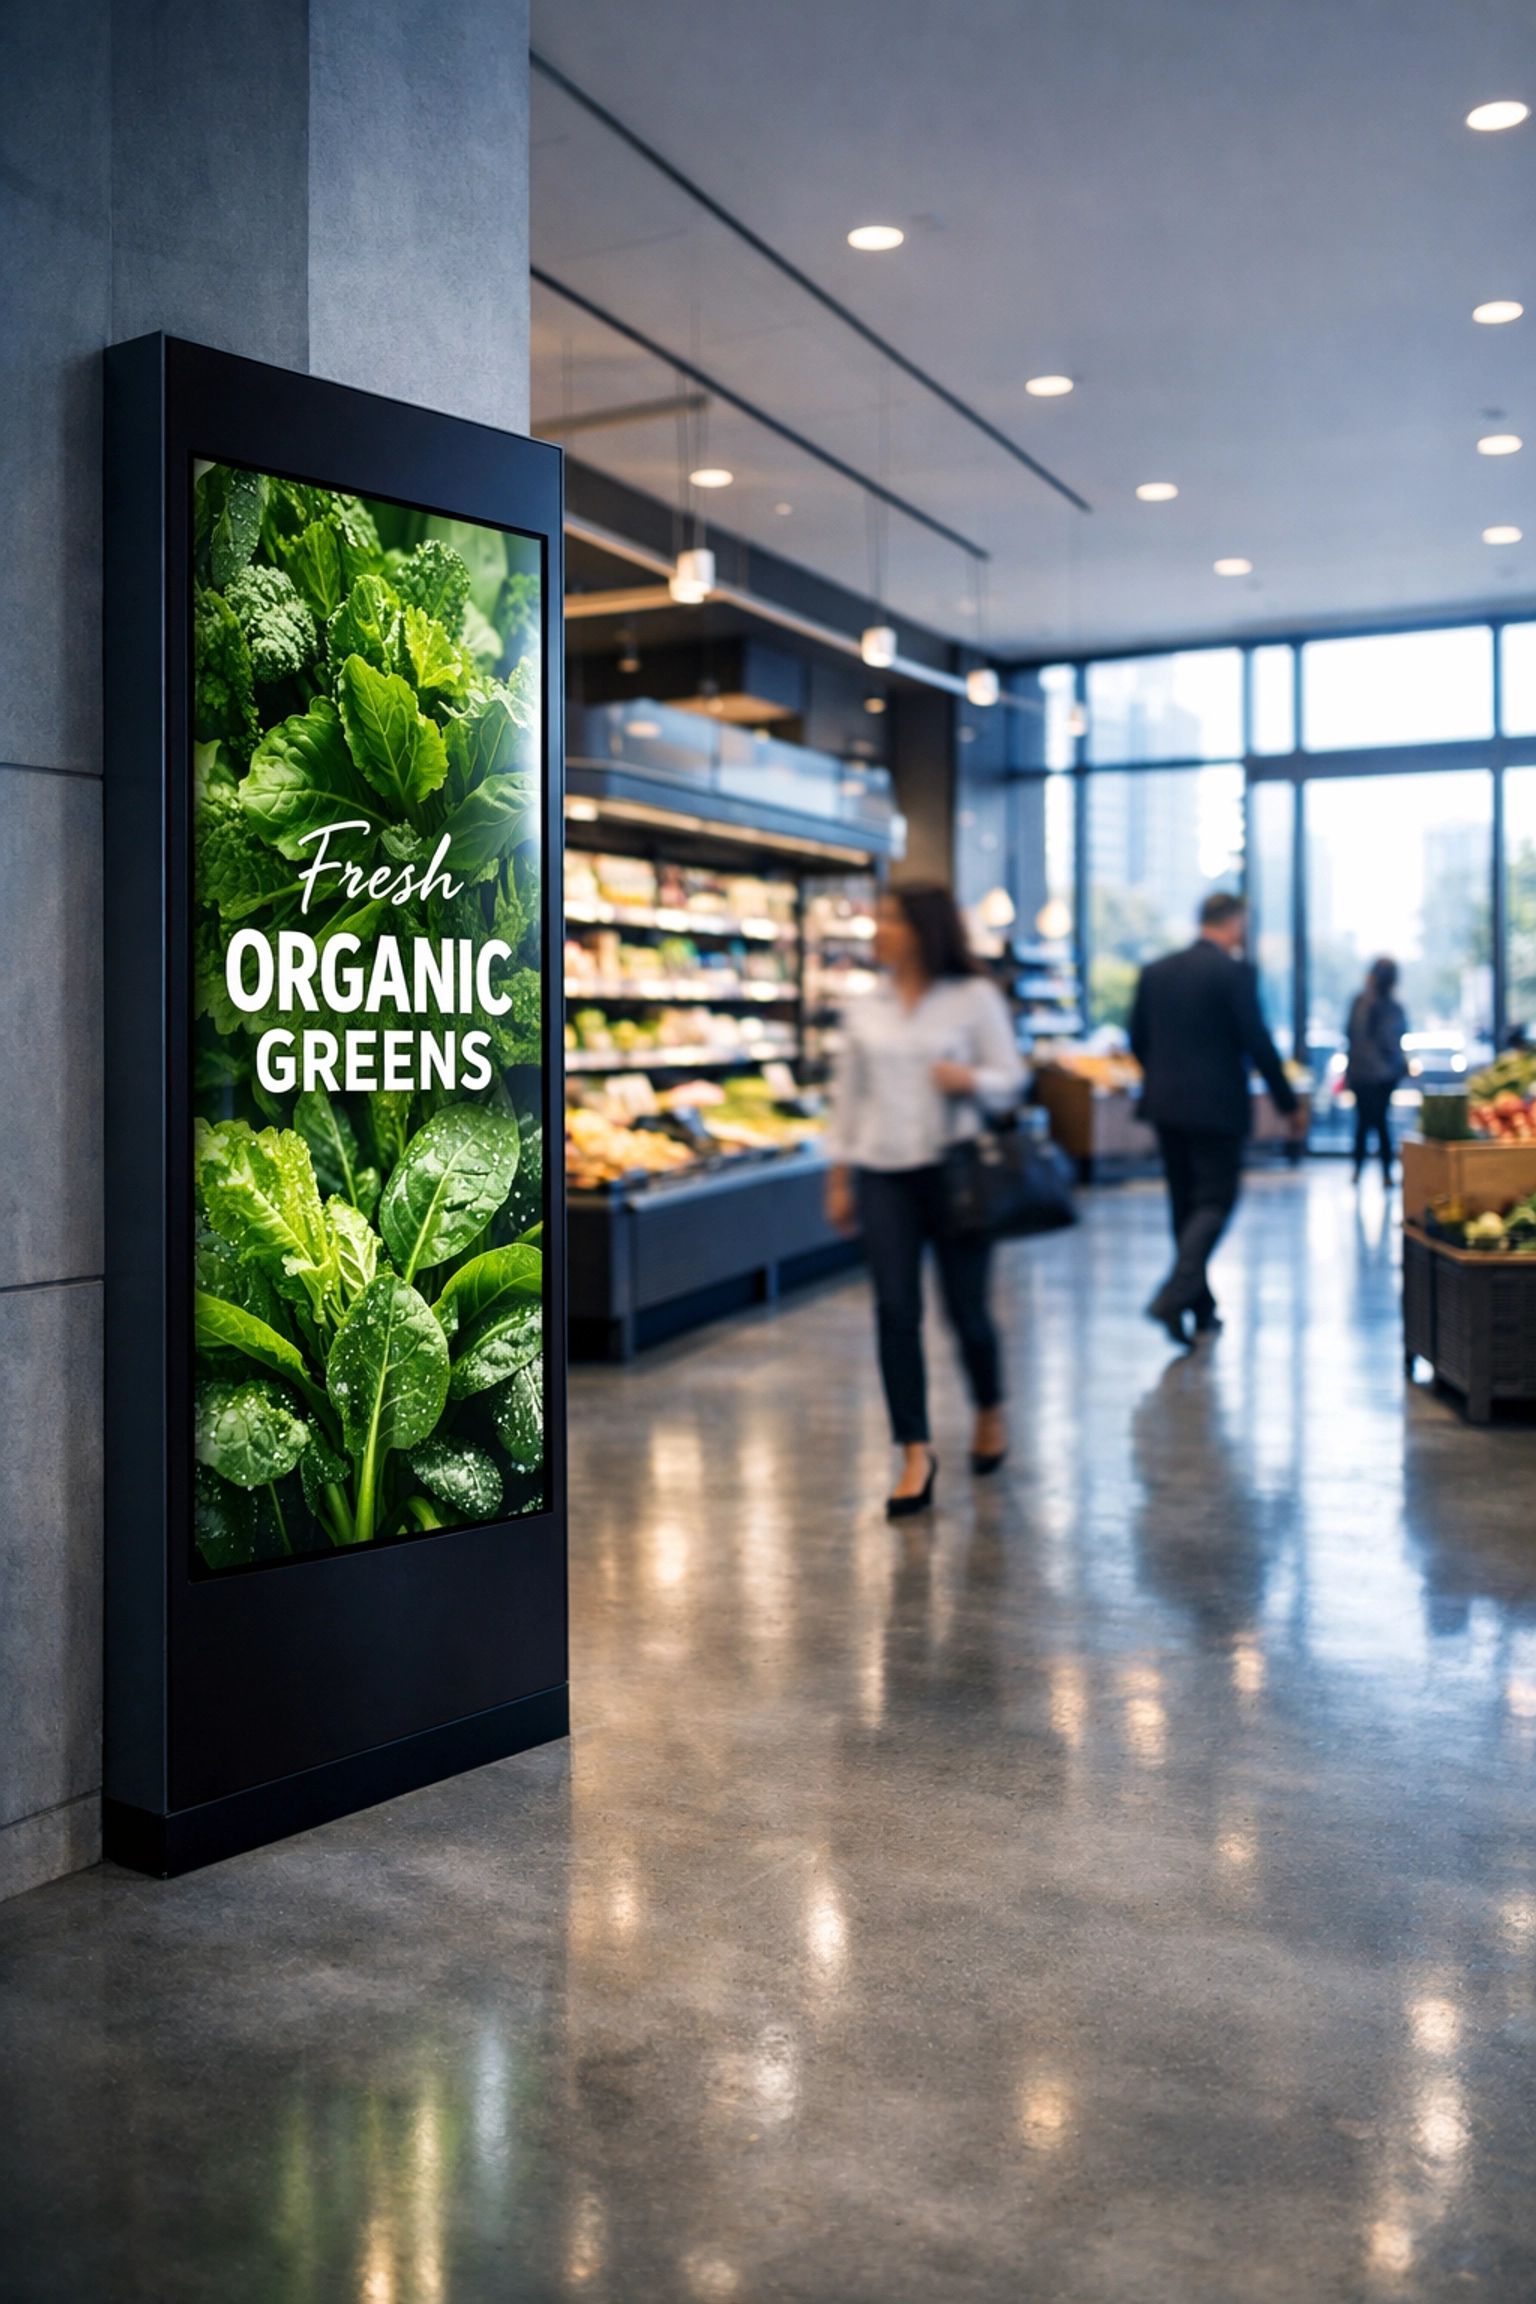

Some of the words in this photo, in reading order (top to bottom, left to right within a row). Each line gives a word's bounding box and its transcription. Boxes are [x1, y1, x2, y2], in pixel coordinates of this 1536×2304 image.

[298, 820, 464, 914] Fresh
[226, 928, 513, 1016] ORGANIC
[256, 1028, 492, 1093] GREENS
